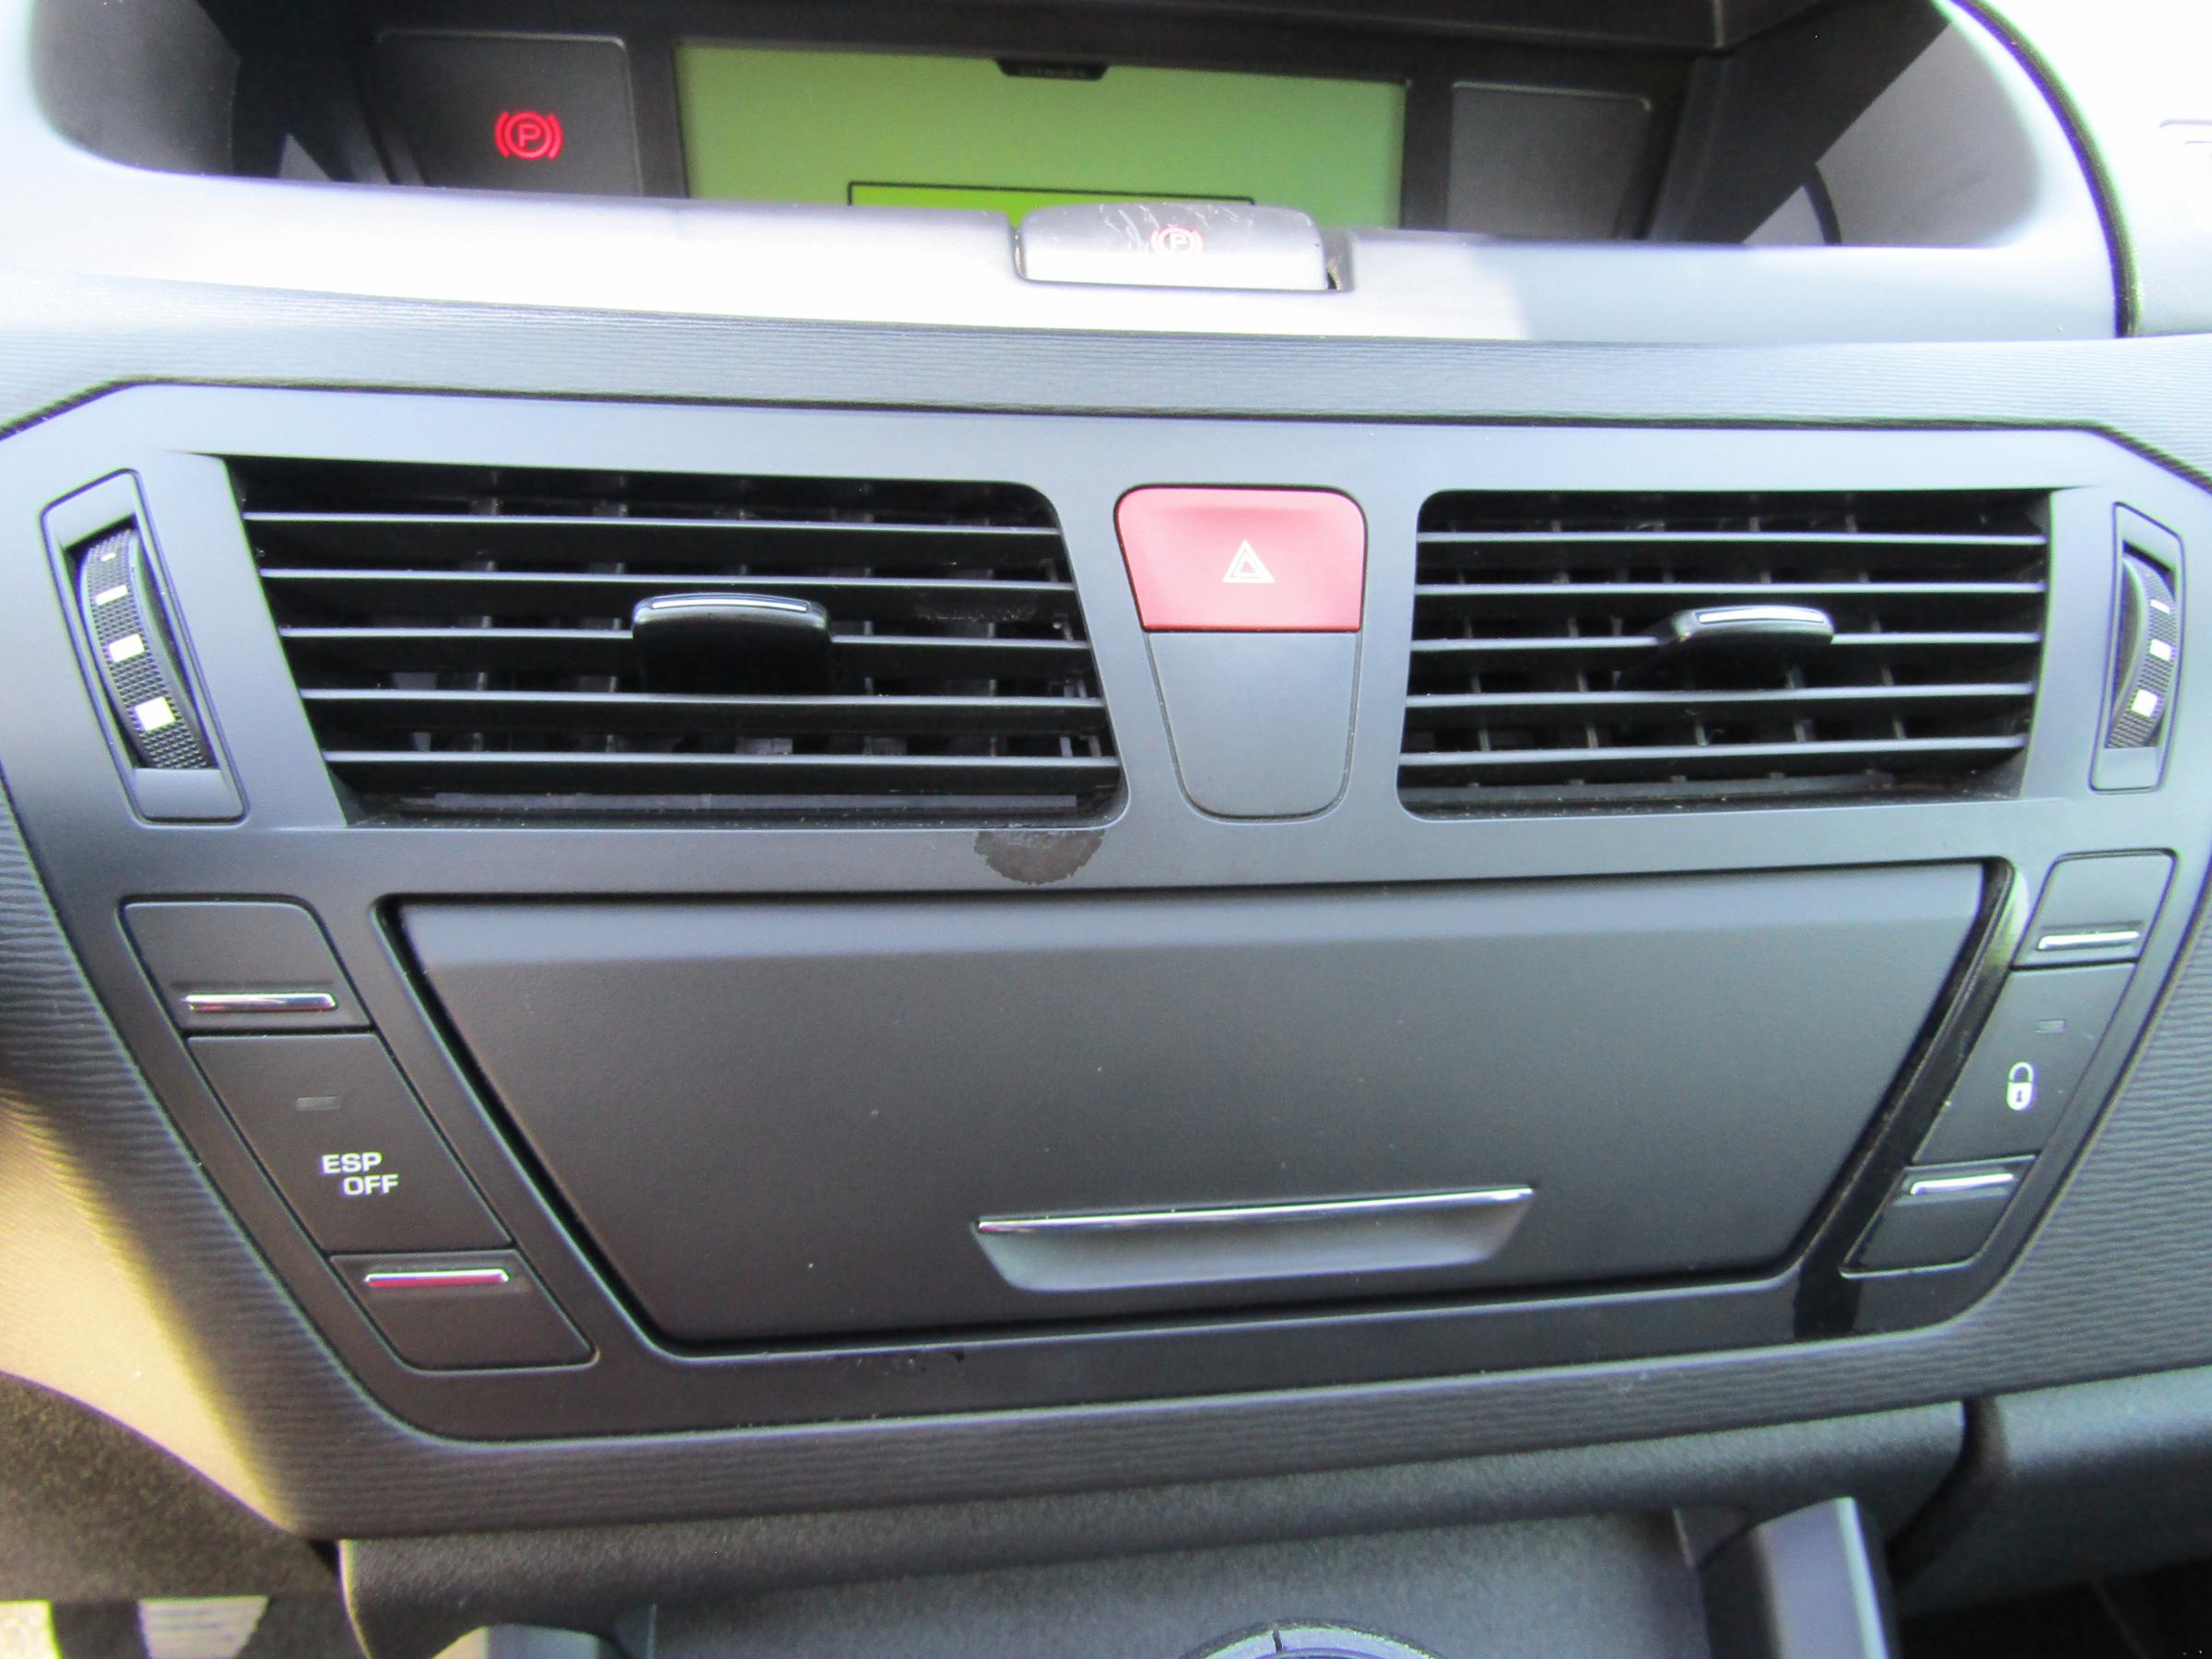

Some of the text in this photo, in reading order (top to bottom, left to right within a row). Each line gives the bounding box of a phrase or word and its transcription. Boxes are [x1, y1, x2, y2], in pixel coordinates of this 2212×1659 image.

[518, 123, 542, 148] P
[322, 1151, 382, 1174] ESP
[342, 1173, 399, 1195] OFF
